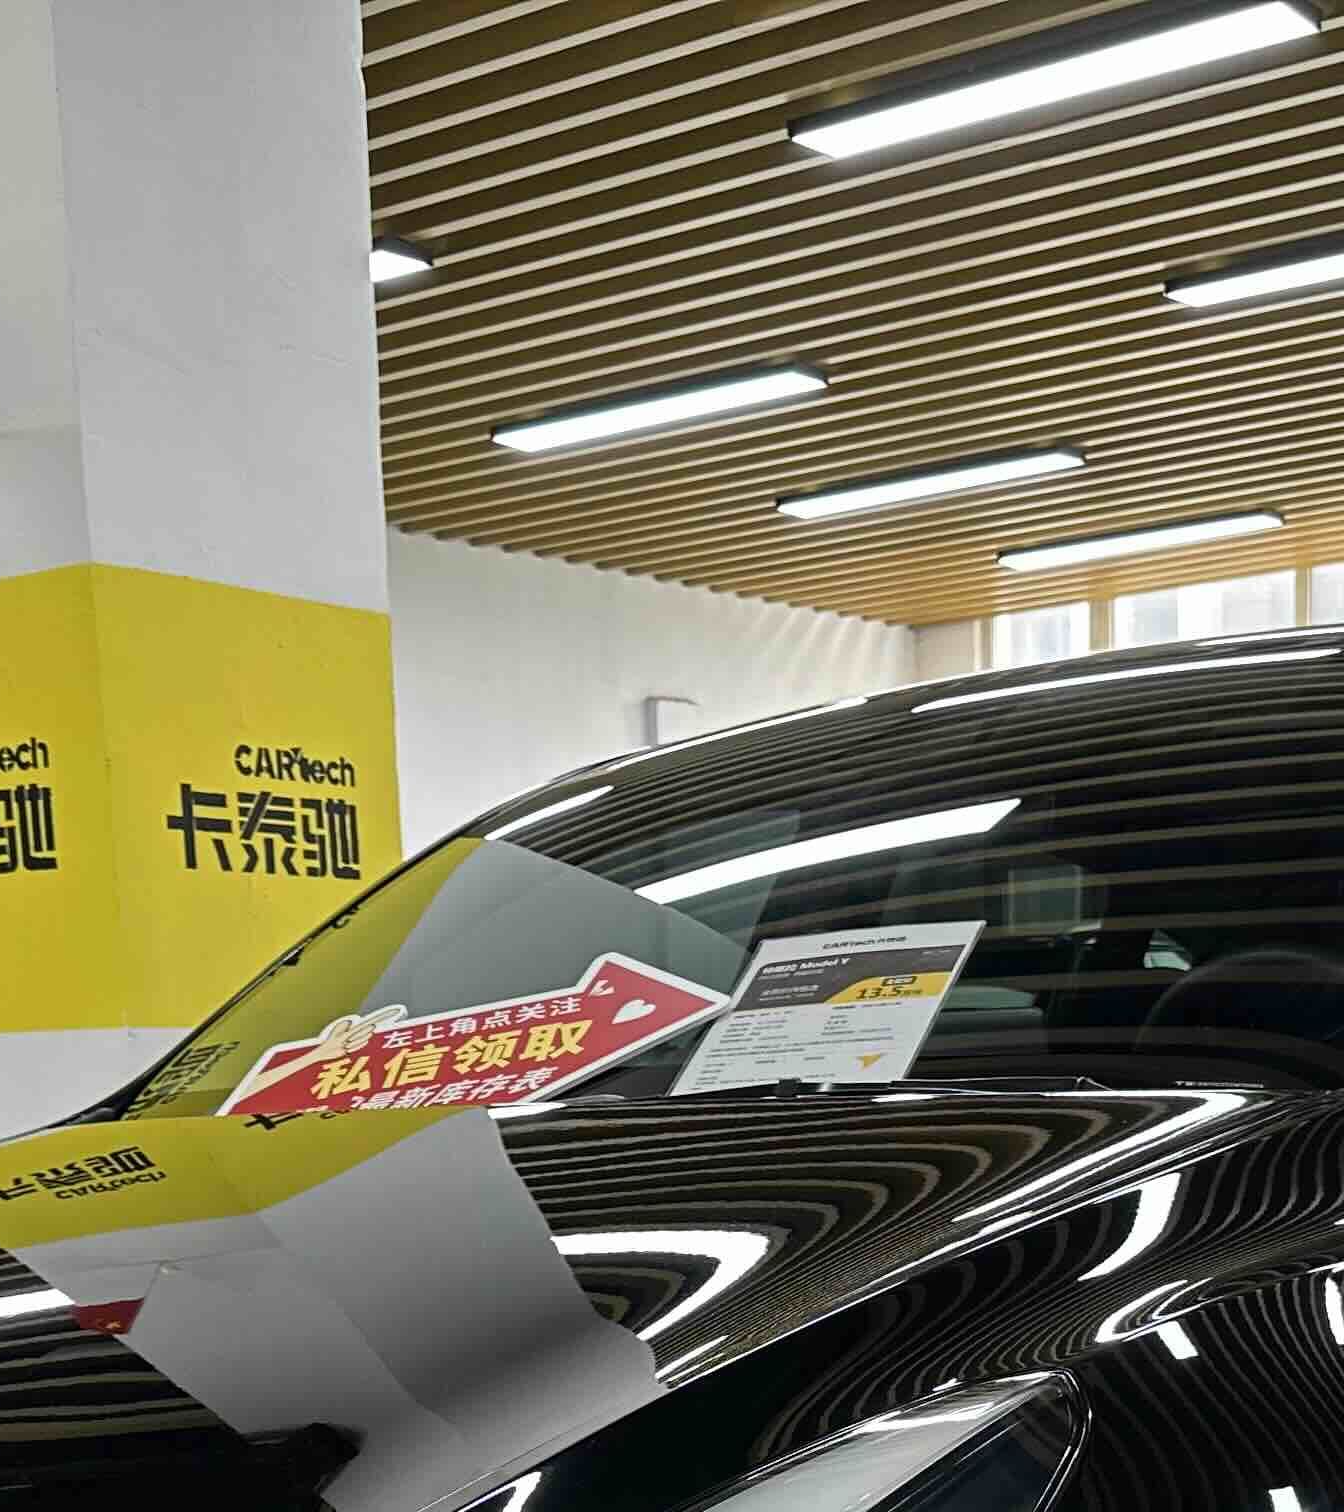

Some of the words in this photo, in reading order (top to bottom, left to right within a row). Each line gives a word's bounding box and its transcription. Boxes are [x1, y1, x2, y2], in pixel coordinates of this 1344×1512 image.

[233, 743, 357, 787] CARtech
[166, 783, 362, 881] 卡泰驰
[382, 996, 583, 1049] 左上角点关注
[311, 1020, 593, 1099] 私信领取
